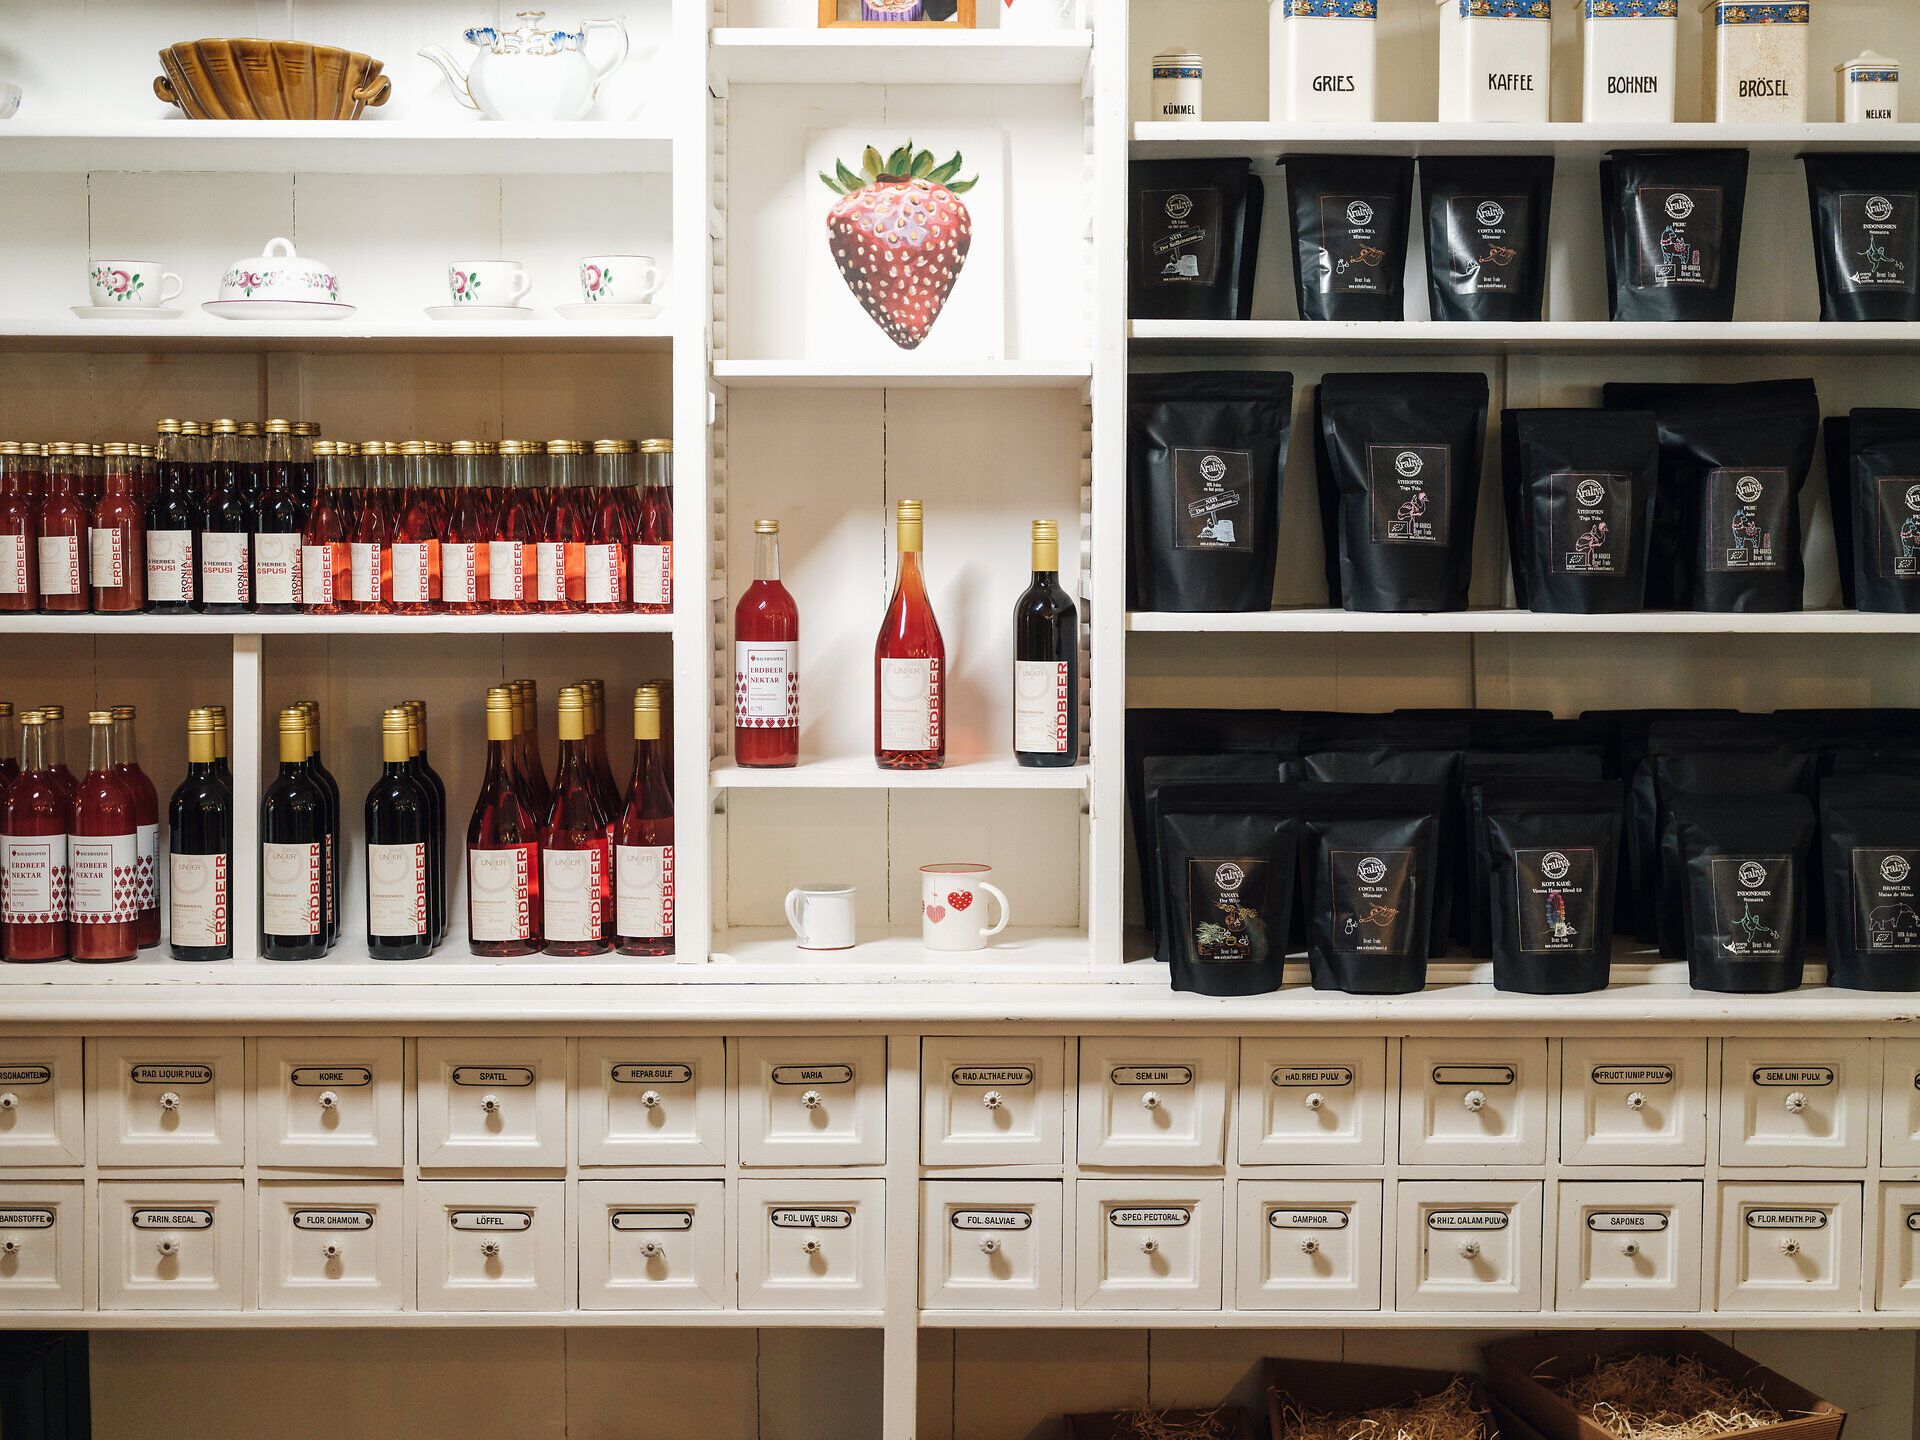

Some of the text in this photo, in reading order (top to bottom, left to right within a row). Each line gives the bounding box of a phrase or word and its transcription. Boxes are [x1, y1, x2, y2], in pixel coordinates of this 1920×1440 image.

[1163, 102, 1196, 115] KÜMMEL
[1312, 75, 1355, 92] GRIES
[1488, 73, 1534, 91] KAFFEE
[1607, 76, 1658, 94] BOHNEN
[1739, 76, 1789, 97] BRÖSEL
[1865, 109, 1892, 119] NELKEN
[17, 535, 26, 593] ERDBEER
[69, 536, 79, 593] ERDBEER
[112, 528, 121, 586] ERDBEER
[322, 546, 332, 603] ERDBEER
[371, 544, 379, 601] ERDBEER
[419, 544, 428, 601] ERDBEER
[466, 545, 475, 602] ERDBEER
[514, 543, 522, 600] ERDBEER
[555, 544, 565, 601] ERDBEER
[608, 545, 619, 601] ERDBEER
[662, 546, 670, 603] ERDBEER
[929, 659, 939, 749] ERDBEER
[1056, 662, 1067, 752] ERDBEER
[215, 855, 226, 945] ERDBEER
[309, 844, 320, 934] ERDBEER
[415, 844, 427, 934] ERDBEER
[516, 849, 529, 939] ERDBEER
[590, 850, 601, 939] ERDBEER
[662, 847, 673, 936] ERDBEER
[319, 1073, 344, 1081] KORKE
[479, 1073, 507, 1081] SPATEL
[147, 1215, 171, 1223] FARIN.
[476, 1215, 504, 1225] LÖFFEL
[821, 1214, 838, 1222] URSI
[984, 1216, 1015, 1224] SALVIAE
[1610, 1217, 1645, 1225] SAPONES
